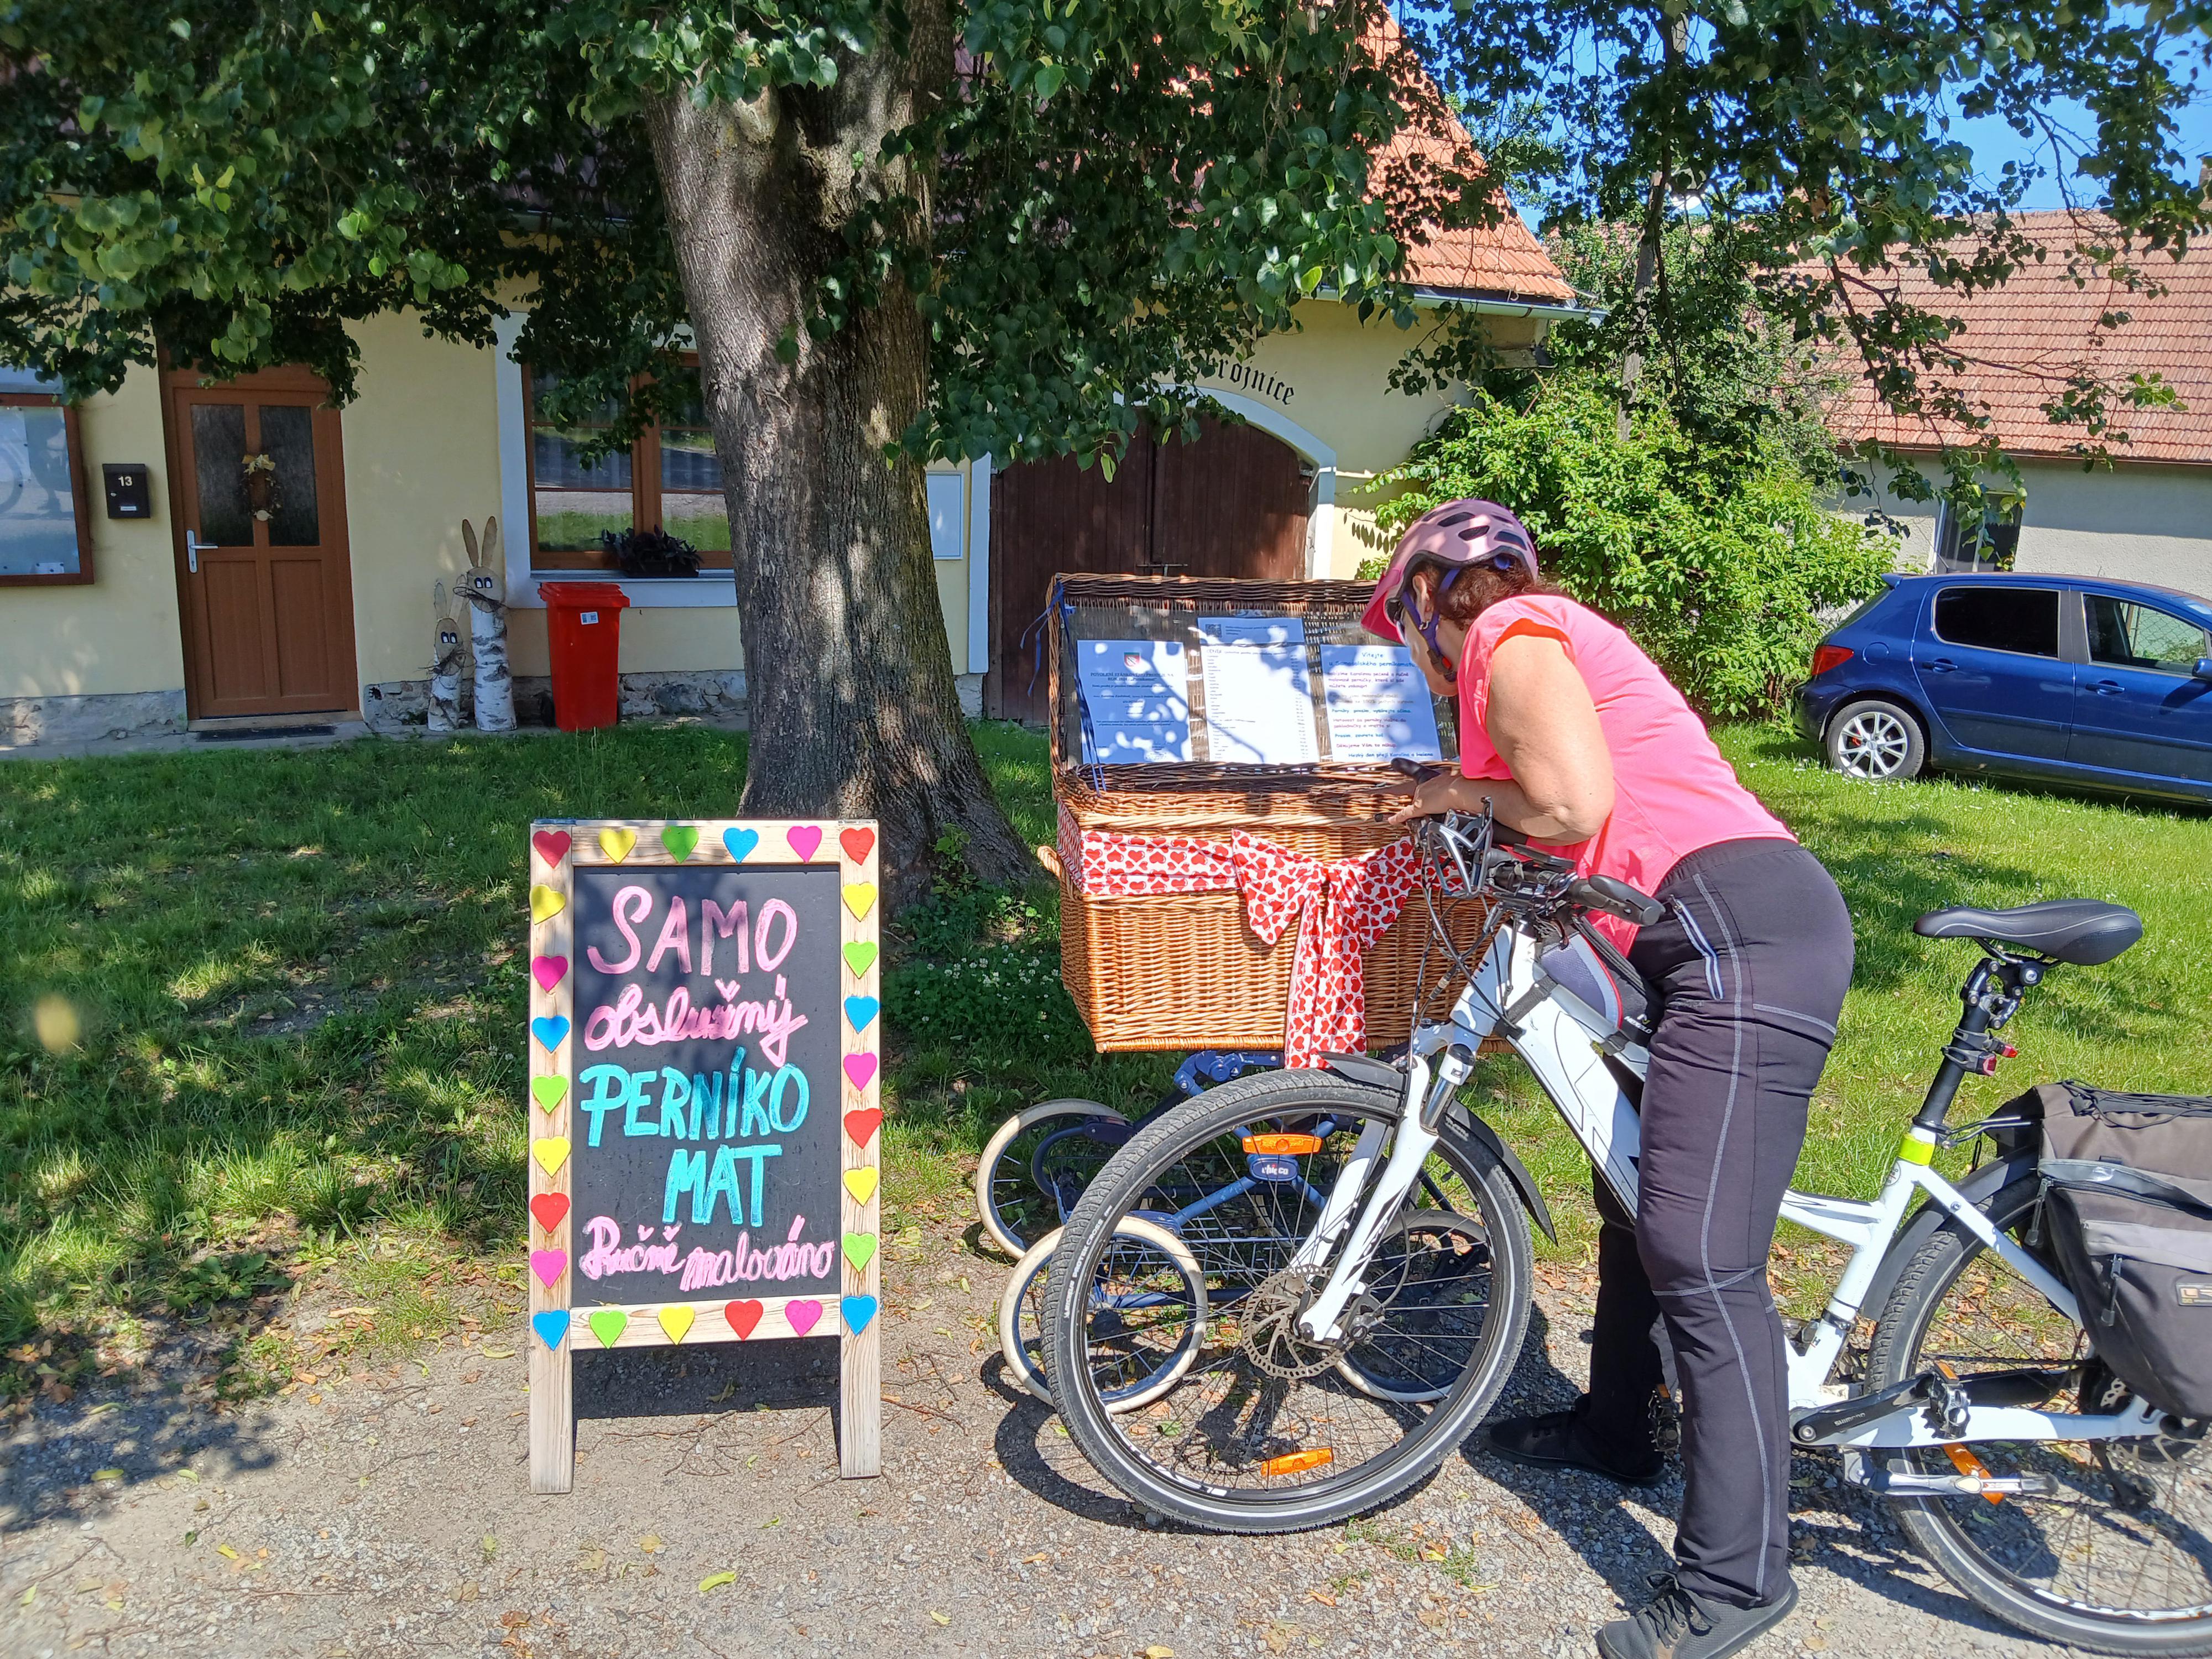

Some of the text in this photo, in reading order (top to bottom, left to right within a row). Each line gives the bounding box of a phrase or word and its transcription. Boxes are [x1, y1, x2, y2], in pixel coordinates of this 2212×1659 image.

[1208, 357, 1295, 406] rojnice
[118, 476, 133, 487] 13
[586, 885, 798, 977] SAMO
[578, 1046, 811, 1147] PERNÍKO
[662, 1143, 783, 1228] MAT
[578, 1214, 836, 1292] Ručně malováno
[1086, 1218, 1104, 1245] CROSS
